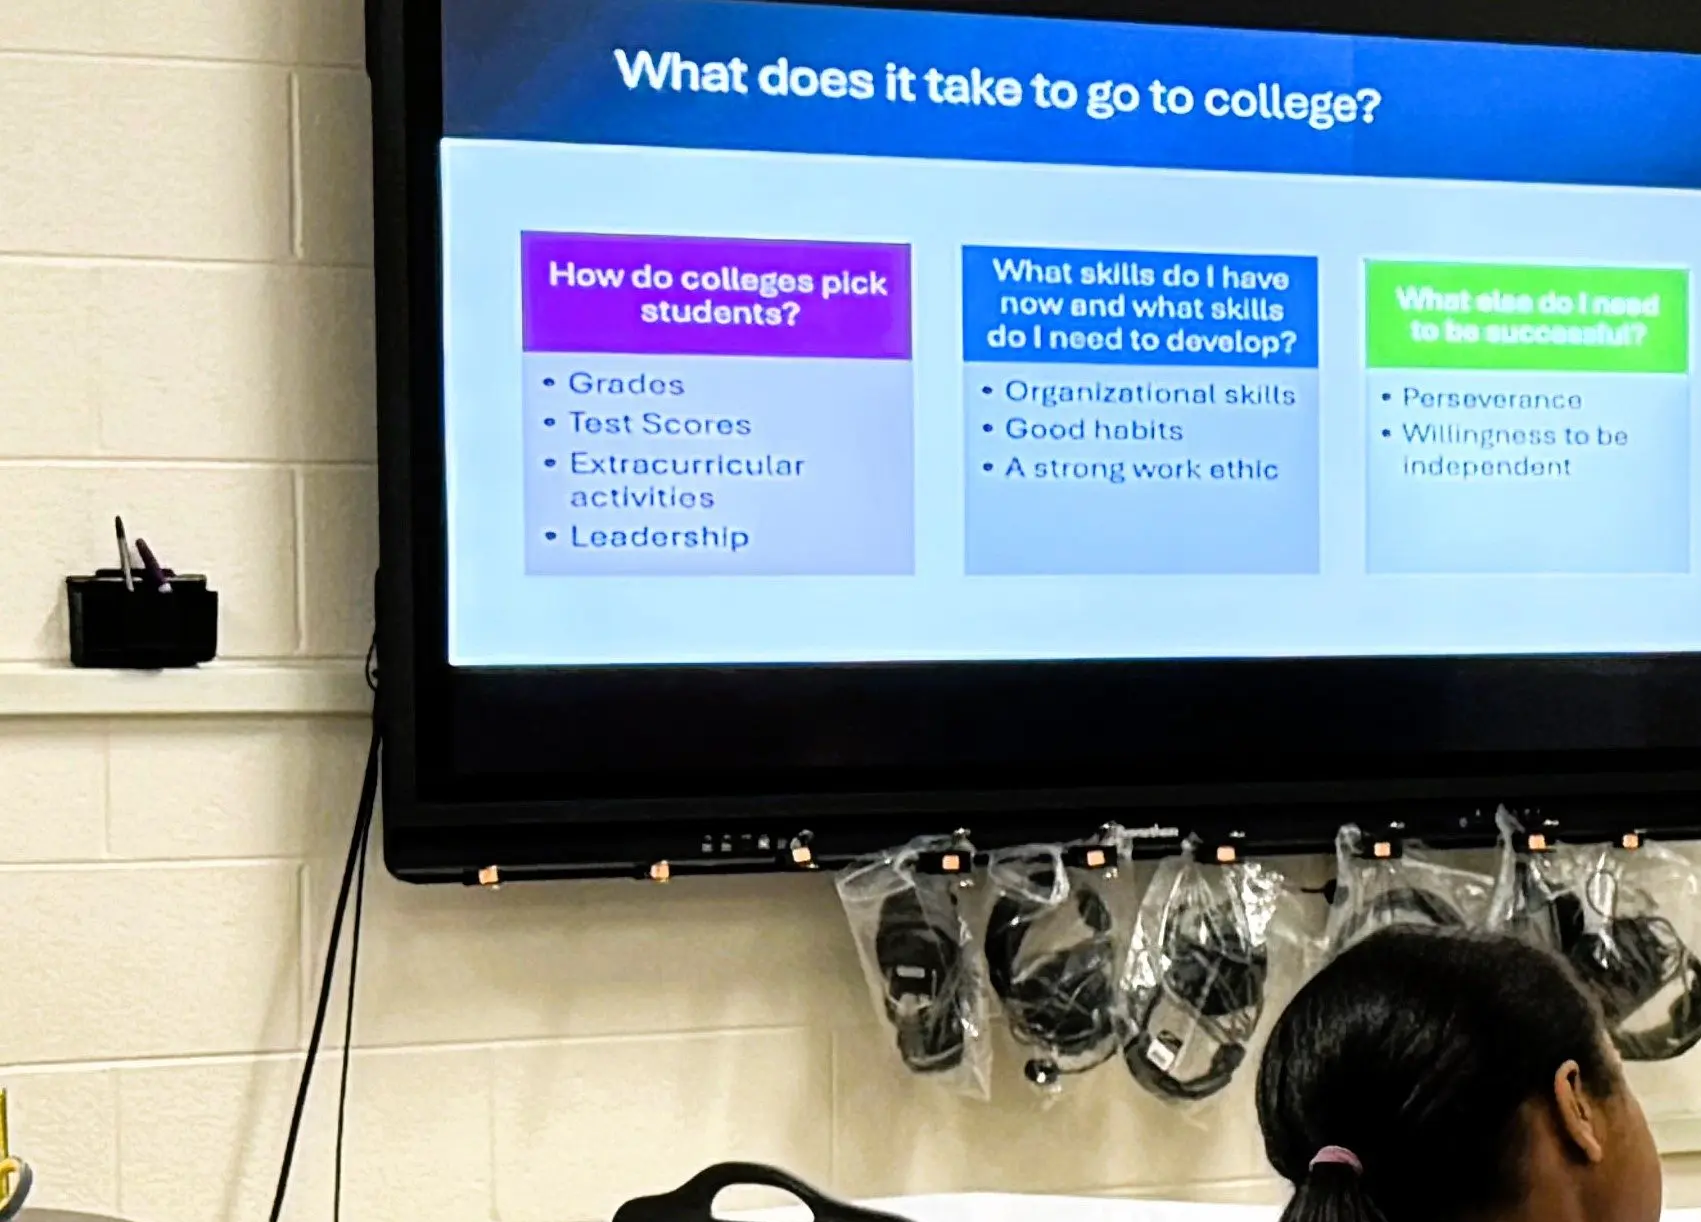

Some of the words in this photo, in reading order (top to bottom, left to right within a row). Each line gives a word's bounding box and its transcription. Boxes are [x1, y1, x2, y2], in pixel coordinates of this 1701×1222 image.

[613, 48, 748, 95] What
[758, 58, 874, 100] does
[886, 63, 914, 102] it
[928, 68, 1022, 107] take
[1031, 72, 1077, 109] to
[1087, 81, 1140, 121] go
[1148, 78, 1194, 116] to
[1204, 86, 1381, 129] college?
[549, 261, 625, 288] How
[632, 264, 673, 290] do
[681, 267, 814, 298] colleges
[821, 270, 887, 299] pick
[993, 257, 1072, 284] What
[1080, 261, 1155, 287] skills
[1163, 264, 1199, 288] do
[1206, 265, 1215, 288] I
[1223, 266, 1290, 291] have
[640, 299, 801, 327] students?
[1000, 296, 1063, 316] now
[1070, 294, 1126, 318] and
[1132, 295, 1204, 320] what
[1211, 298, 1284, 322] skills
[1396, 286, 1471, 313] What
[1476, 287, 1534, 314] else
[1538, 291, 1574, 315] do
[1579, 292, 1588, 313] I
[1592, 293, 1661, 317] need
[987, 324, 1027, 349] do
[1033, 325, 1042, 348] I
[1050, 327, 1123, 350] need
[1130, 330, 1160, 351] to
[1166, 328, 1297, 359] develop?
[1410, 319, 1440, 341] to
[1444, 318, 1479, 343] be
[1484, 321, 1648, 347] successful?
[569, 372, 686, 396] Grades
[1006, 380, 1216, 408] Organizational
[1224, 384, 1297, 406] skills
[1403, 387, 1582, 410] Perseverance
[569, 411, 632, 434] Test
[642, 412, 752, 436] Scores
[1006, 417, 1085, 441] Good
[1095, 419, 1184, 442] habits
[1402, 423, 1557, 449] Willingness
[1565, 427, 1590, 446] to
[1597, 426, 1629, 447] be
[570, 452, 804, 480] Extracurricular
[1004, 456, 1025, 479] A
[1034, 459, 1125, 483] strong
[1133, 459, 1201, 480] work
[1210, 459, 1280, 481] ethic
[1403, 455, 1573, 481] independent
[570, 487, 716, 510] activities
[570, 525, 749, 552] Leadership
